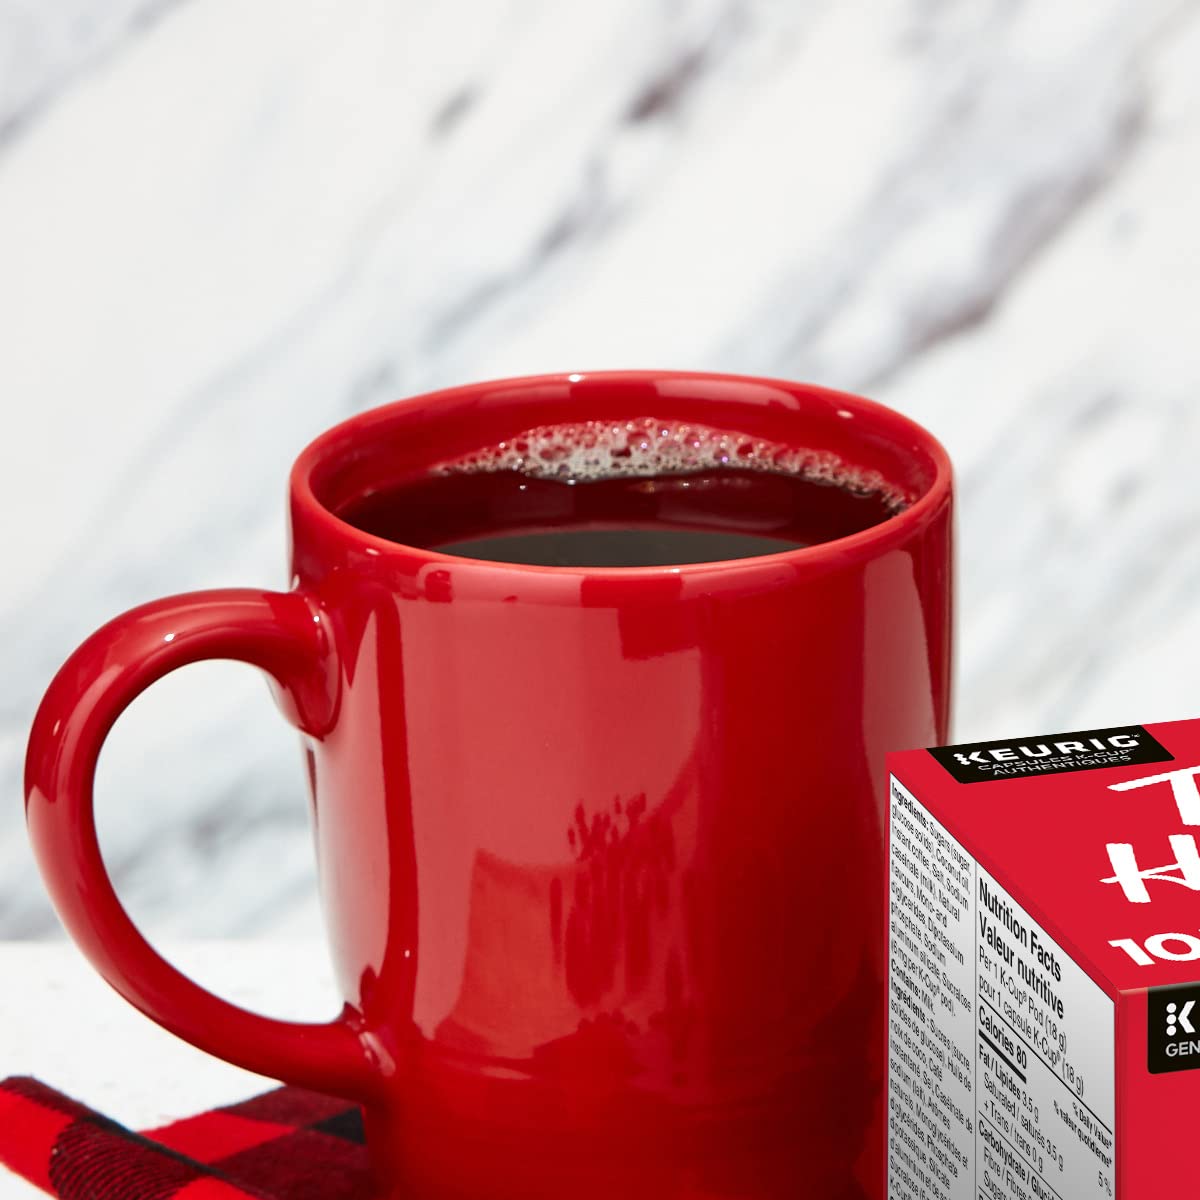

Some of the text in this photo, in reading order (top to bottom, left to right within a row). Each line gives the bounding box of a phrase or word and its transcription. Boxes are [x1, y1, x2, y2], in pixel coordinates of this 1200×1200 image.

[976, 755, 1075, 770] CAPSULES
[989, 755, 1133, 775] AUTHENTIQUES
[979, 875, 1060, 984] Nutrition Facts
[979, 910, 1063, 1021] Valeur nutritive
[979, 944, 991, 973] Per
[1028, 996, 1042, 1027] Pod
[979, 1003, 1026, 1071] Calories 80
[1004, 995, 1031, 1041] capsule
[979, 1043, 1032, 1114] Fat Lipides 3.5
[979, 1118, 1025, 1183] Carbohydrate
